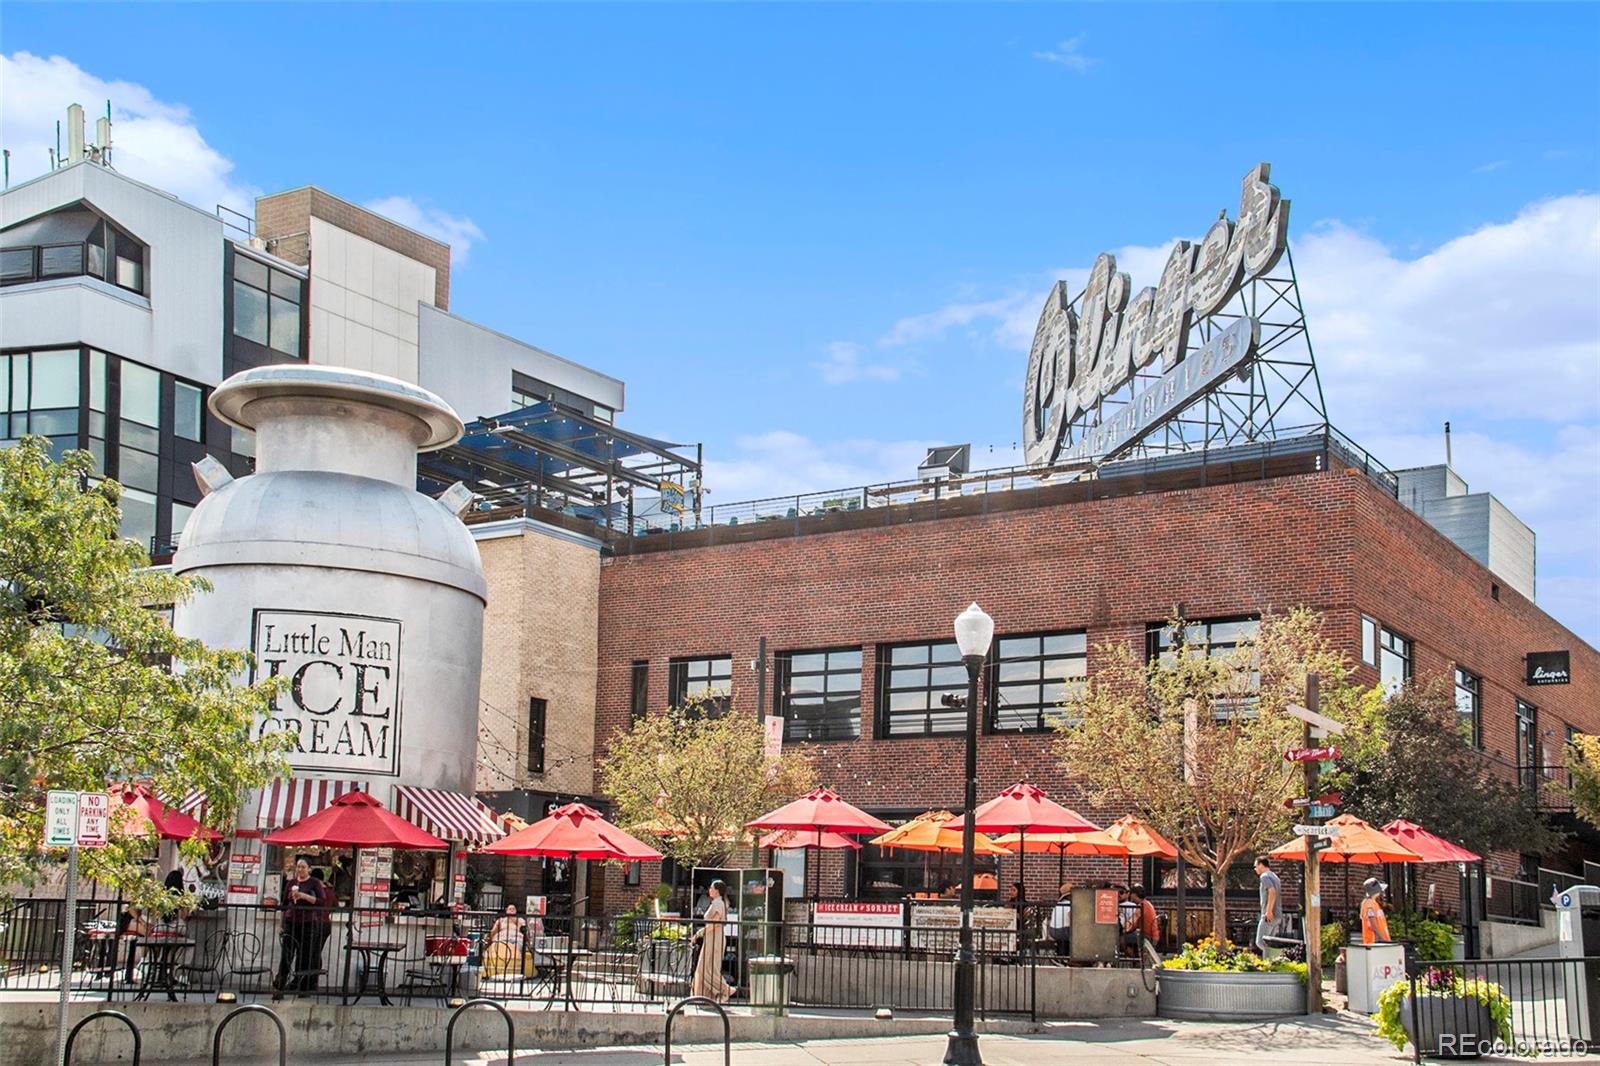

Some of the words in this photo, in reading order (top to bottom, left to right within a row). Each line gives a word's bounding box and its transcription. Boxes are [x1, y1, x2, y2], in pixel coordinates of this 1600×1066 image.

[264, 624, 330, 655] Little
[338, 628, 392, 661] Man
[264, 659, 390, 720] ICE
[259, 717, 390, 759] CREAM
[50, 796, 76, 805] LOADING
[88, 796, 100, 807] NO
[55, 807, 70, 815] ONLY
[81, 807, 107, 818] PARKING
[56, 818, 67, 826] ALL
[87, 818, 99, 826] ANY
[53, 827, 70, 835] TIMES
[86, 825, 100, 834] TIME
[824, 903, 835, 912] ICE
[836, 903, 858, 912] CREAM
[865, 904, 898, 913] SORBET
